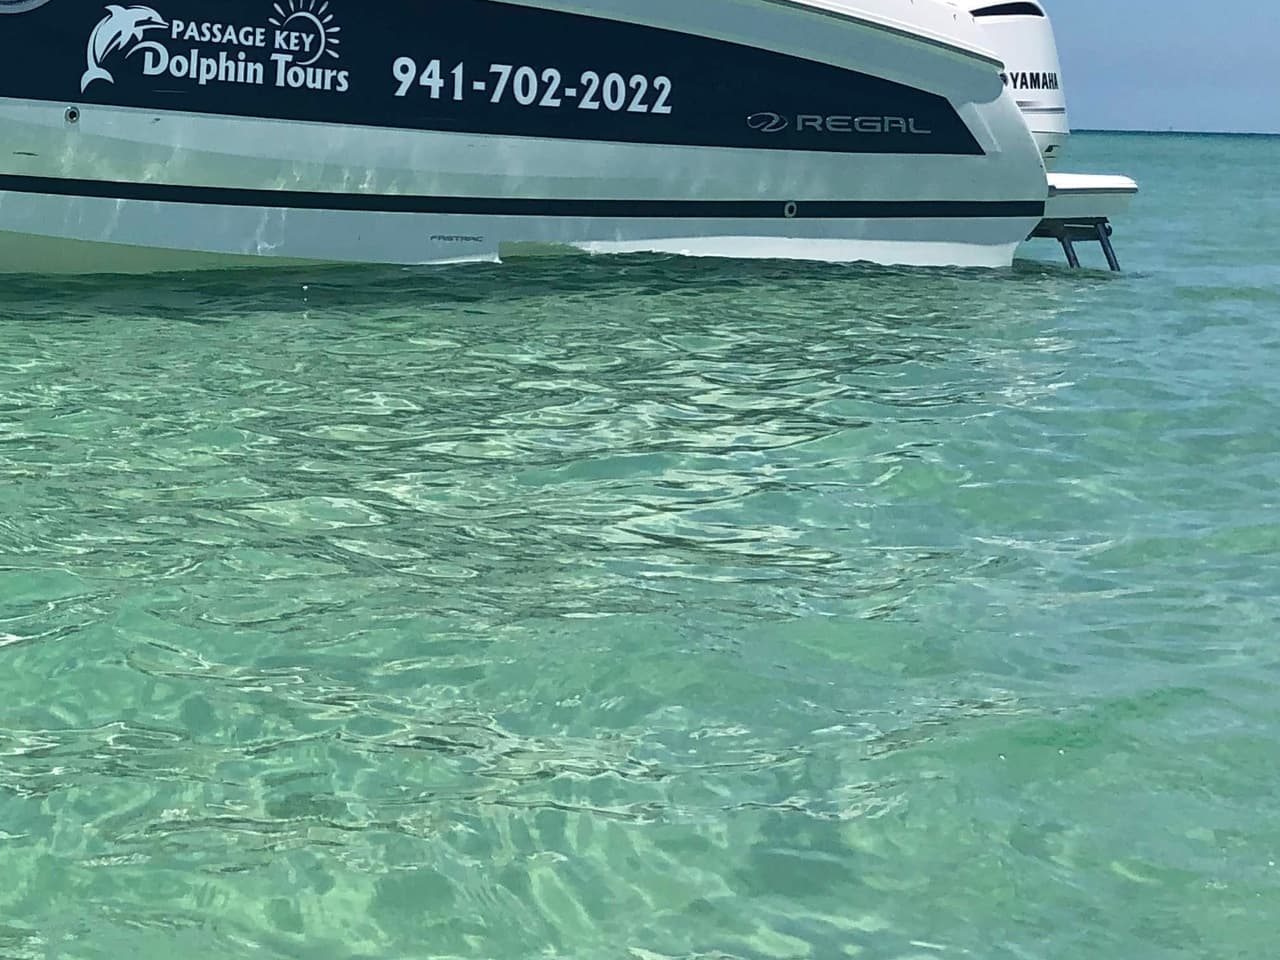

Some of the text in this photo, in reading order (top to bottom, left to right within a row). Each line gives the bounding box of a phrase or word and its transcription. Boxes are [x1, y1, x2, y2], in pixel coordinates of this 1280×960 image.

[171, 19, 315, 52] PASSAGE KEY
[125, 41, 349, 92] Dolphin Tours
[1009, 71, 1059, 90] YAMAHA
[392, 56, 672, 114] 941-702-2022
[796, 114, 932, 134] REGAL
